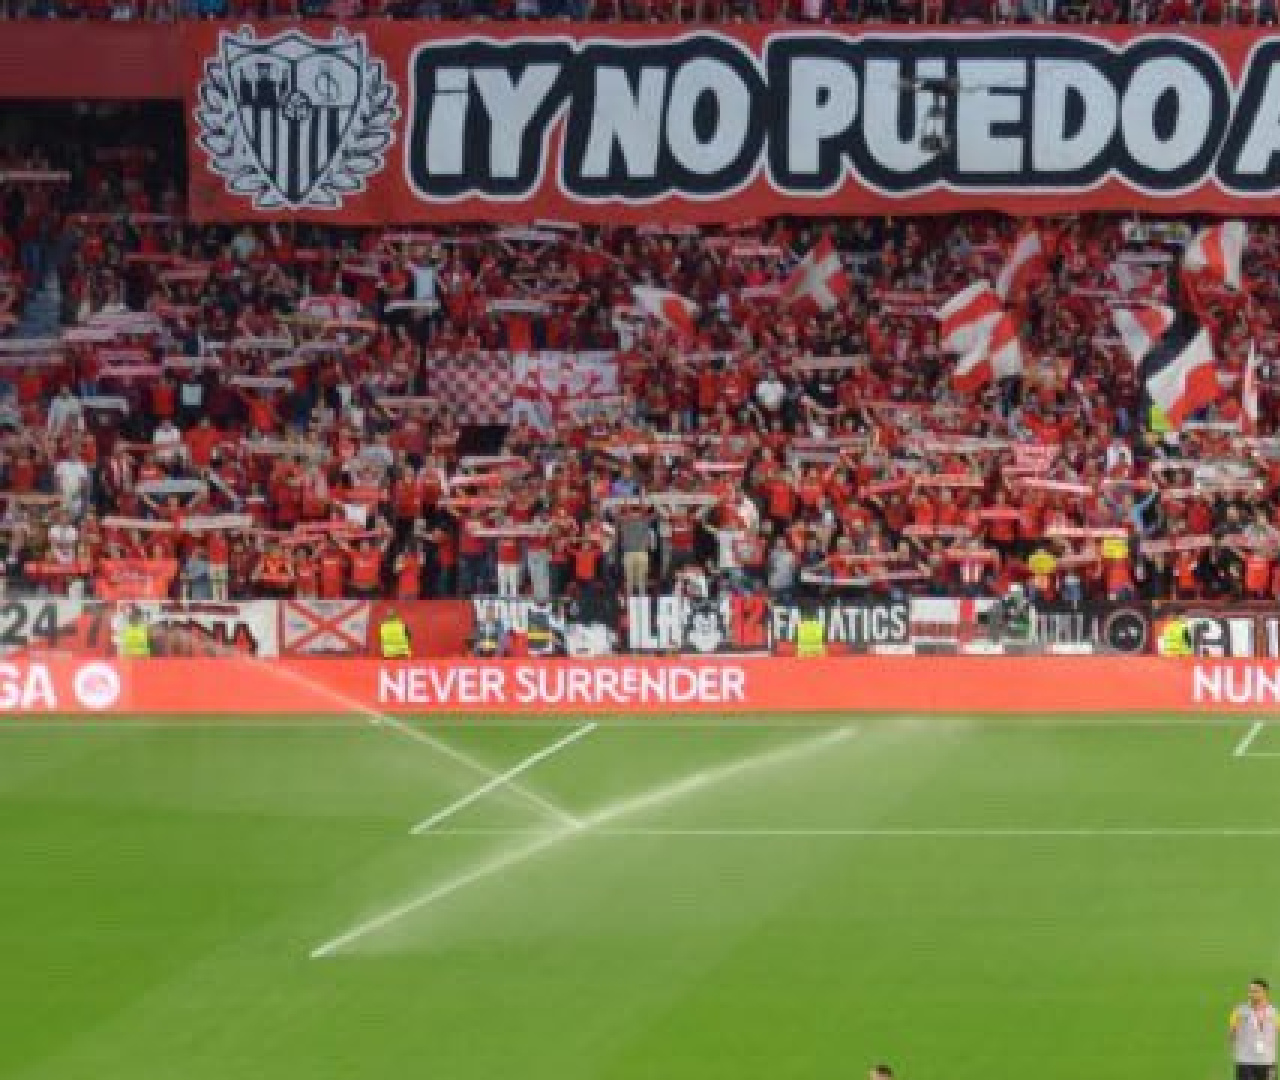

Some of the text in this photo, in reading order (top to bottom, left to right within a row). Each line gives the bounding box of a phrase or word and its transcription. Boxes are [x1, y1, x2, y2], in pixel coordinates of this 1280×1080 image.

[580, 57, 752, 177] NO
[786, 57, 1213, 176] PUEDO
[380, 667, 745, 703] NEVER SURRENDER
